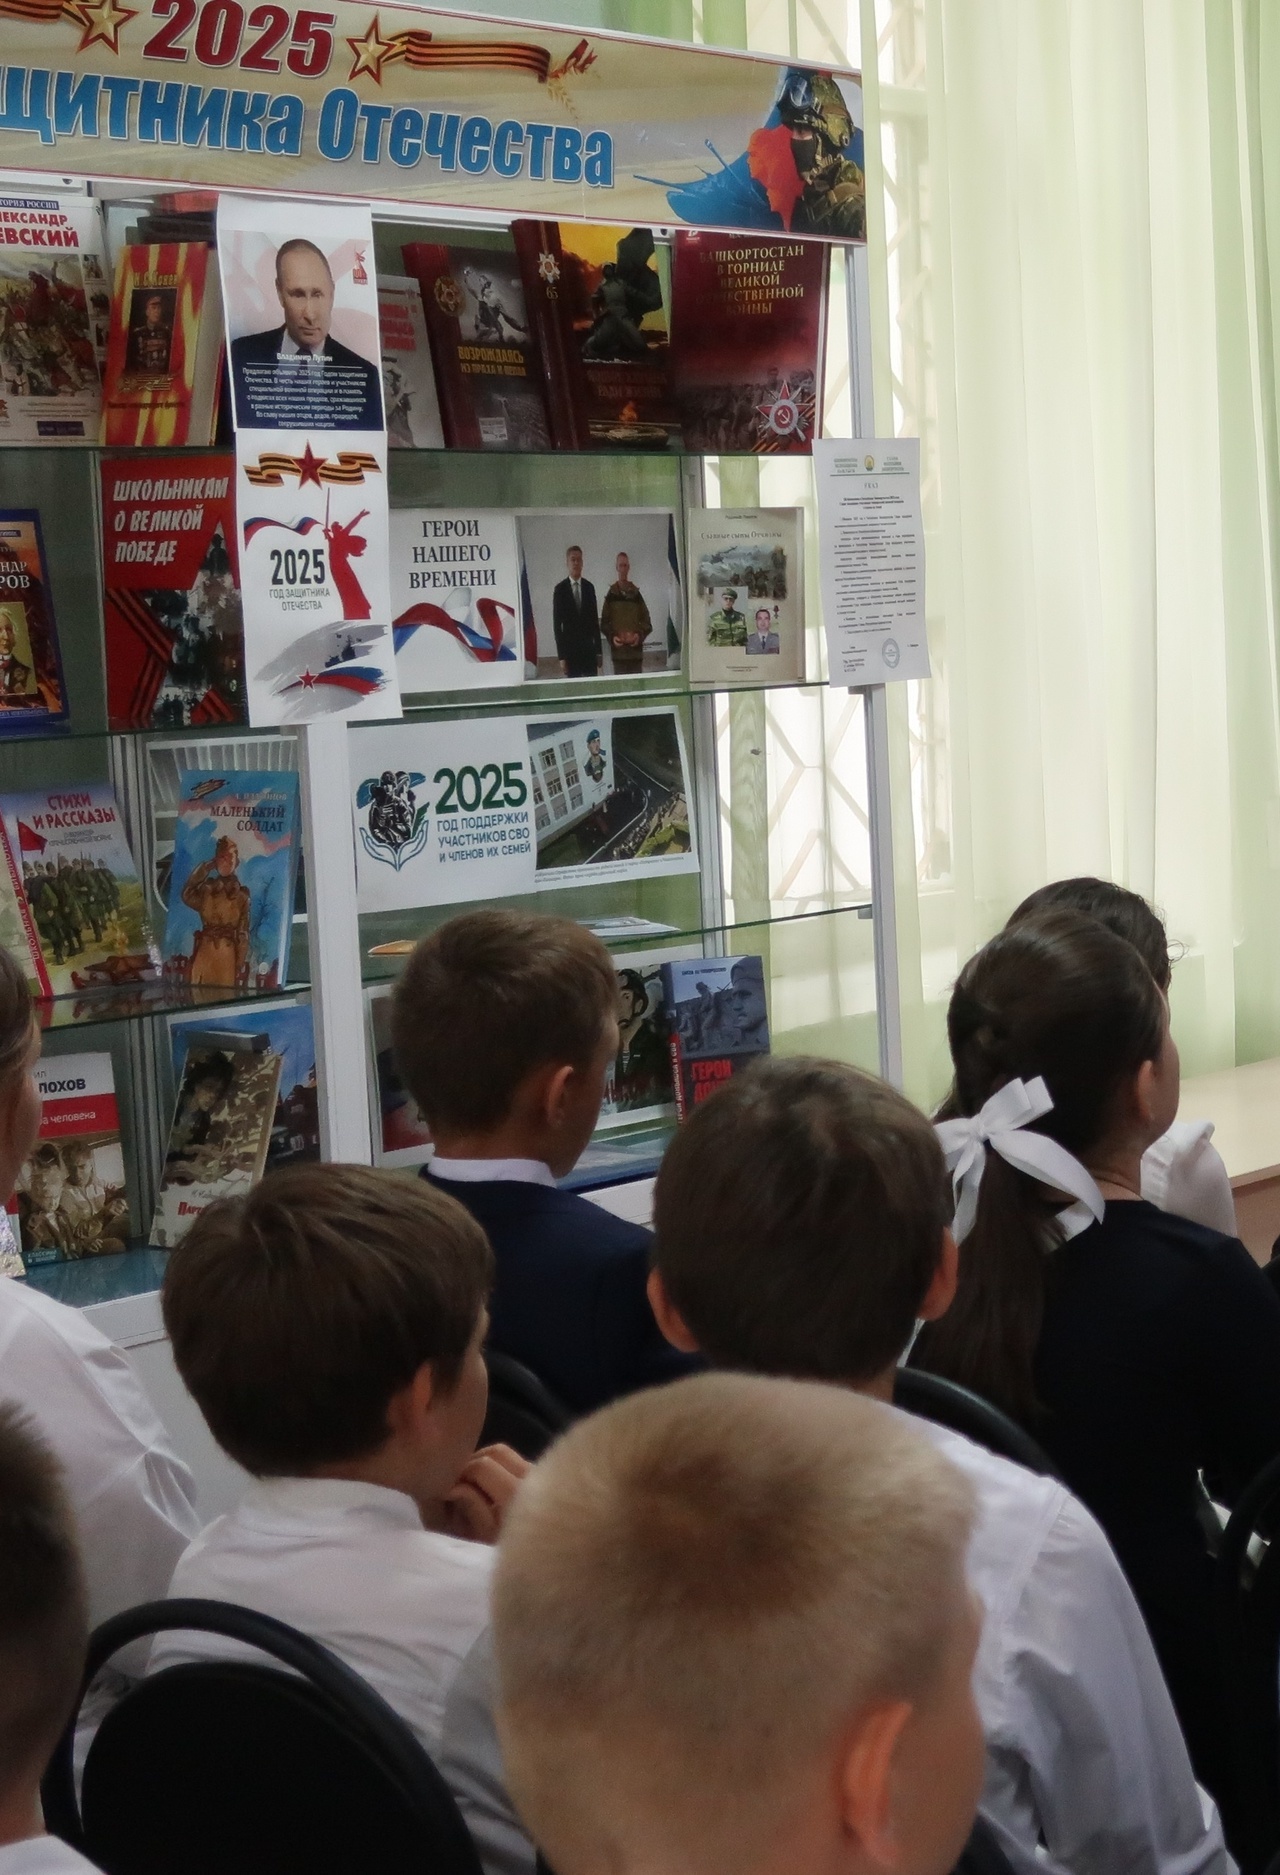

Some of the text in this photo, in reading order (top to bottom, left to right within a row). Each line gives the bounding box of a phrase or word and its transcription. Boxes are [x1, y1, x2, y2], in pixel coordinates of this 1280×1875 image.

[142, 0, 336, 78] 2025
[317, 86, 614, 189] Отечества
[27, 201, 58, 209] РОССИИ
[0, 211, 68, 227] ЕКСАНДР
[699, 244, 805, 263] БАШКОРТОСТАН
[717, 260, 785, 276] В ГОРНИЛЕ
[720, 271, 780, 288] ВЕЛИКОЙ
[726, 302, 773, 315] ВОЙНЫ
[457, 346, 524, 363] ВОЗРОЖДАЯСЬ
[113, 477, 229, 502] ШКОЛЬНИКАМ
[114, 504, 204, 533] О ВЕЛИКОЙ
[422, 519, 480, 538] ГЕРОИ
[115, 540, 178, 566] ПОБЕДЕ
[412, 544, 491, 564] НАШЕГО
[269, 548, 326, 586] 2025
[409, 569, 496, 589] ВРЕМЕНИ
[269, 587, 330, 600] ГОД ЗАЩИТНИКА
[281, 600, 323, 611] ОТЕЧЕСТВА
[433, 762, 528, 815] 2025
[47, 792, 92, 811] СТИХИ
[210, 805, 285, 817] МАЛЕНЬКИЙ
[32, 807, 116, 830] И РАССКАЗЫ
[236, 820, 284, 832] СОЛДАТ
[436, 812, 529, 832] ГОД ПОДДЕРЖКИ
[438, 829, 530, 847] УЧАСТНИКОВ СВО
[439, 841, 531, 863] И ЧЛЕНОВ ИХ СЕМЕЙ
[50, 1111, 96, 1123] человека
